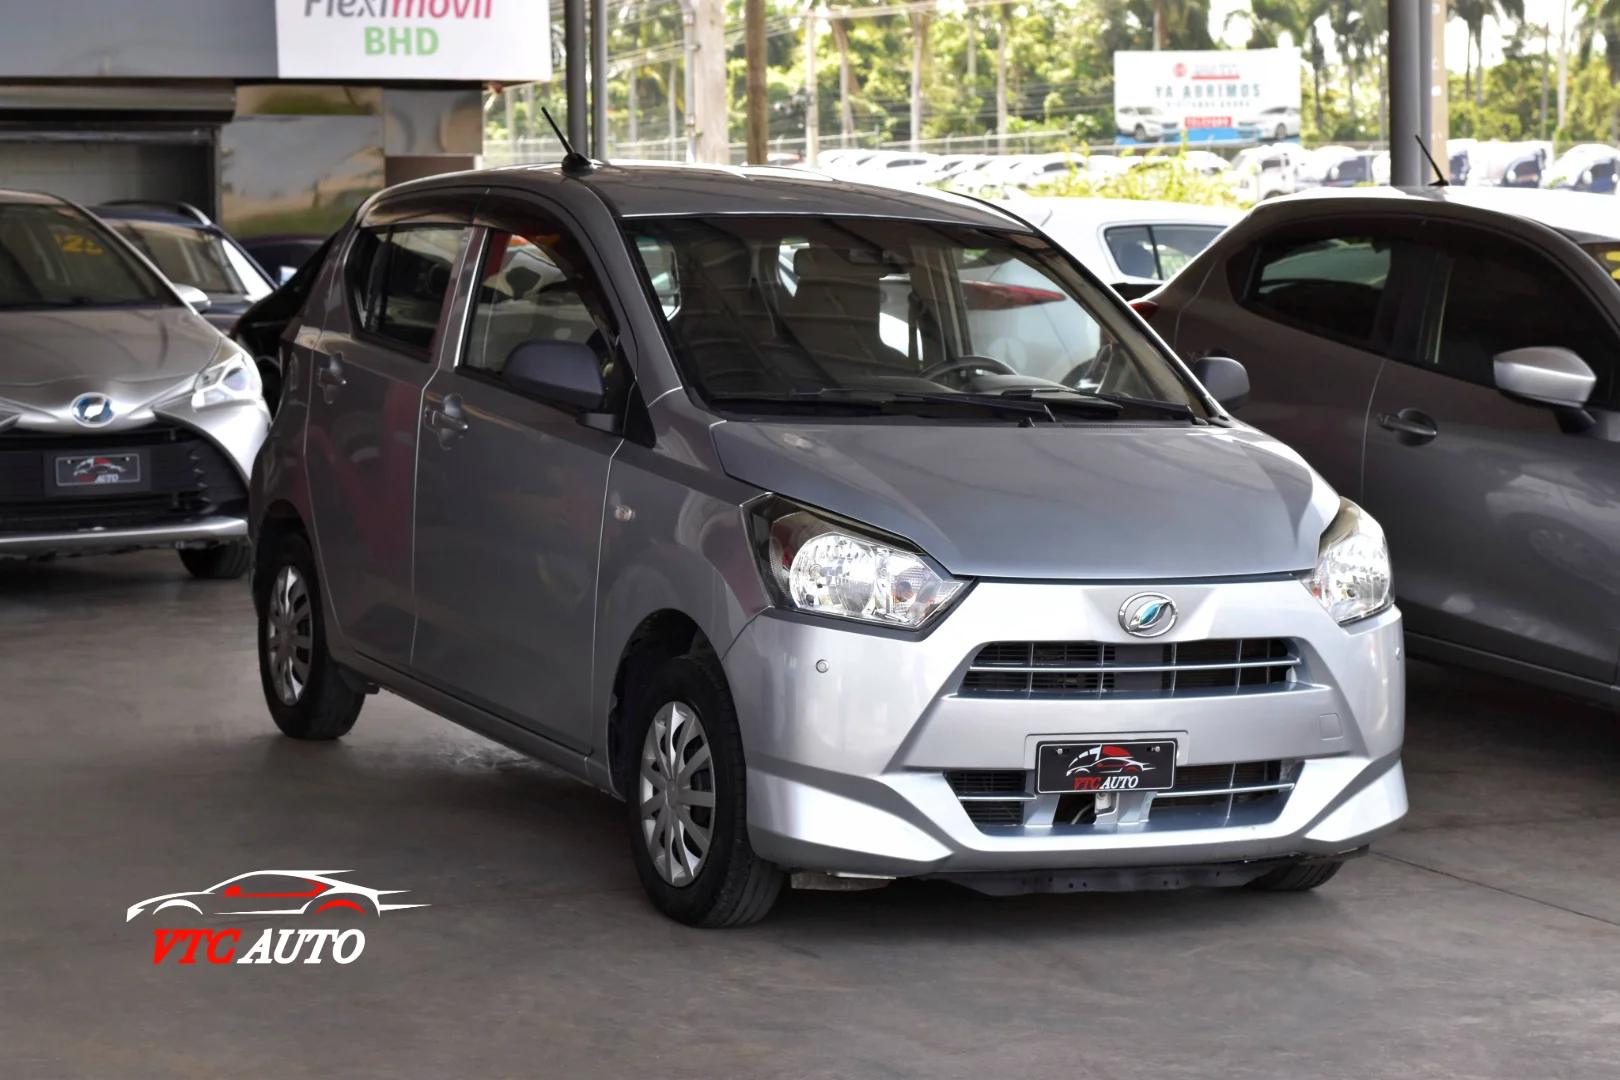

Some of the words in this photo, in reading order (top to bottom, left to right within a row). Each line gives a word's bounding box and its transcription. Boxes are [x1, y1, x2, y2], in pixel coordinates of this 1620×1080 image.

[363, 27, 439, 56] BHD
[1074, 776, 1101, 790] VTC
[1100, 775, 1139, 789] AUTO
